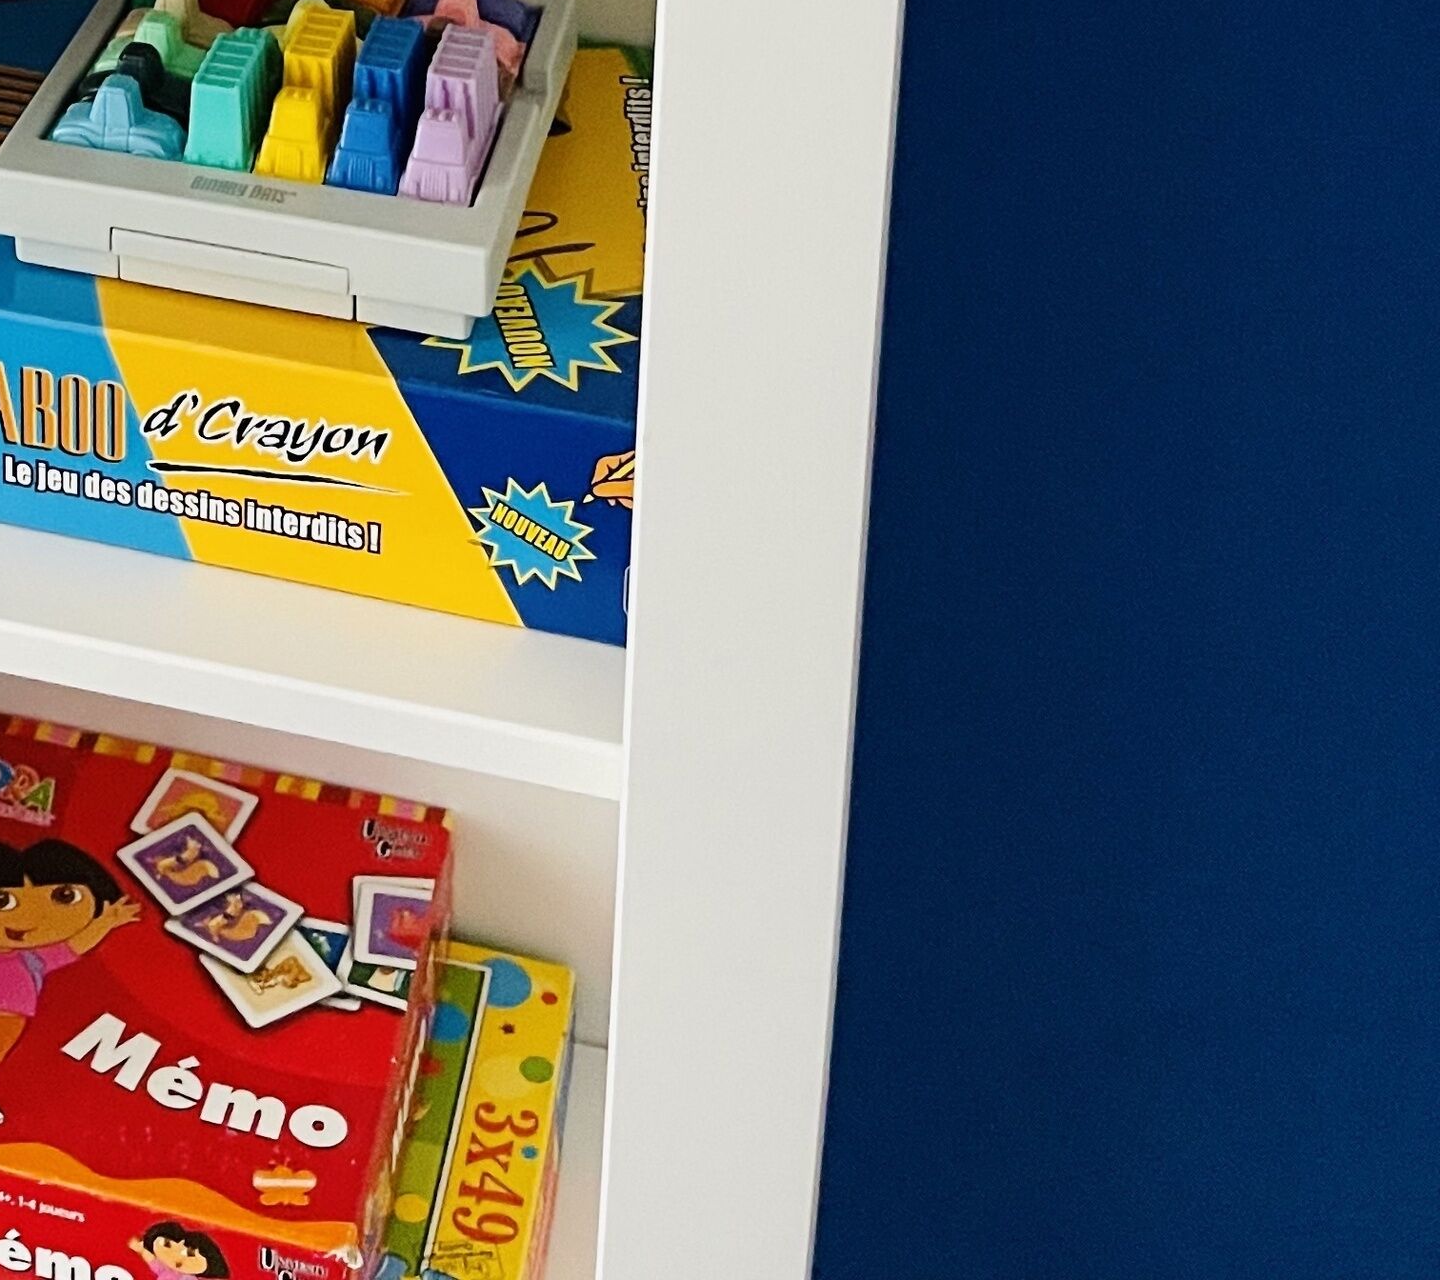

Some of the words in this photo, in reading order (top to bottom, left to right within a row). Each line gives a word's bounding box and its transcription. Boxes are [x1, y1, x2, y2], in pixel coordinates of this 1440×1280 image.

[623, 87, 652, 173] interdits
[142, 391, 390, 462] d'Crayon
[4, 456, 33, 487] Le
[35, 459, 79, 496] jeu
[84, 470, 131, 507] des
[137, 481, 242, 527] dessins
[245, 500, 366, 551] interdits
[366, 523, 382, 554] !
[489, 500, 574, 563] NOUVEAU
[60, 1011, 349, 1148] Mémo
[18, 1194, 37, 1211] 1-4
[38, 1200, 87, 1224] joueurs
[452, 1100, 540, 1245] 3x49
